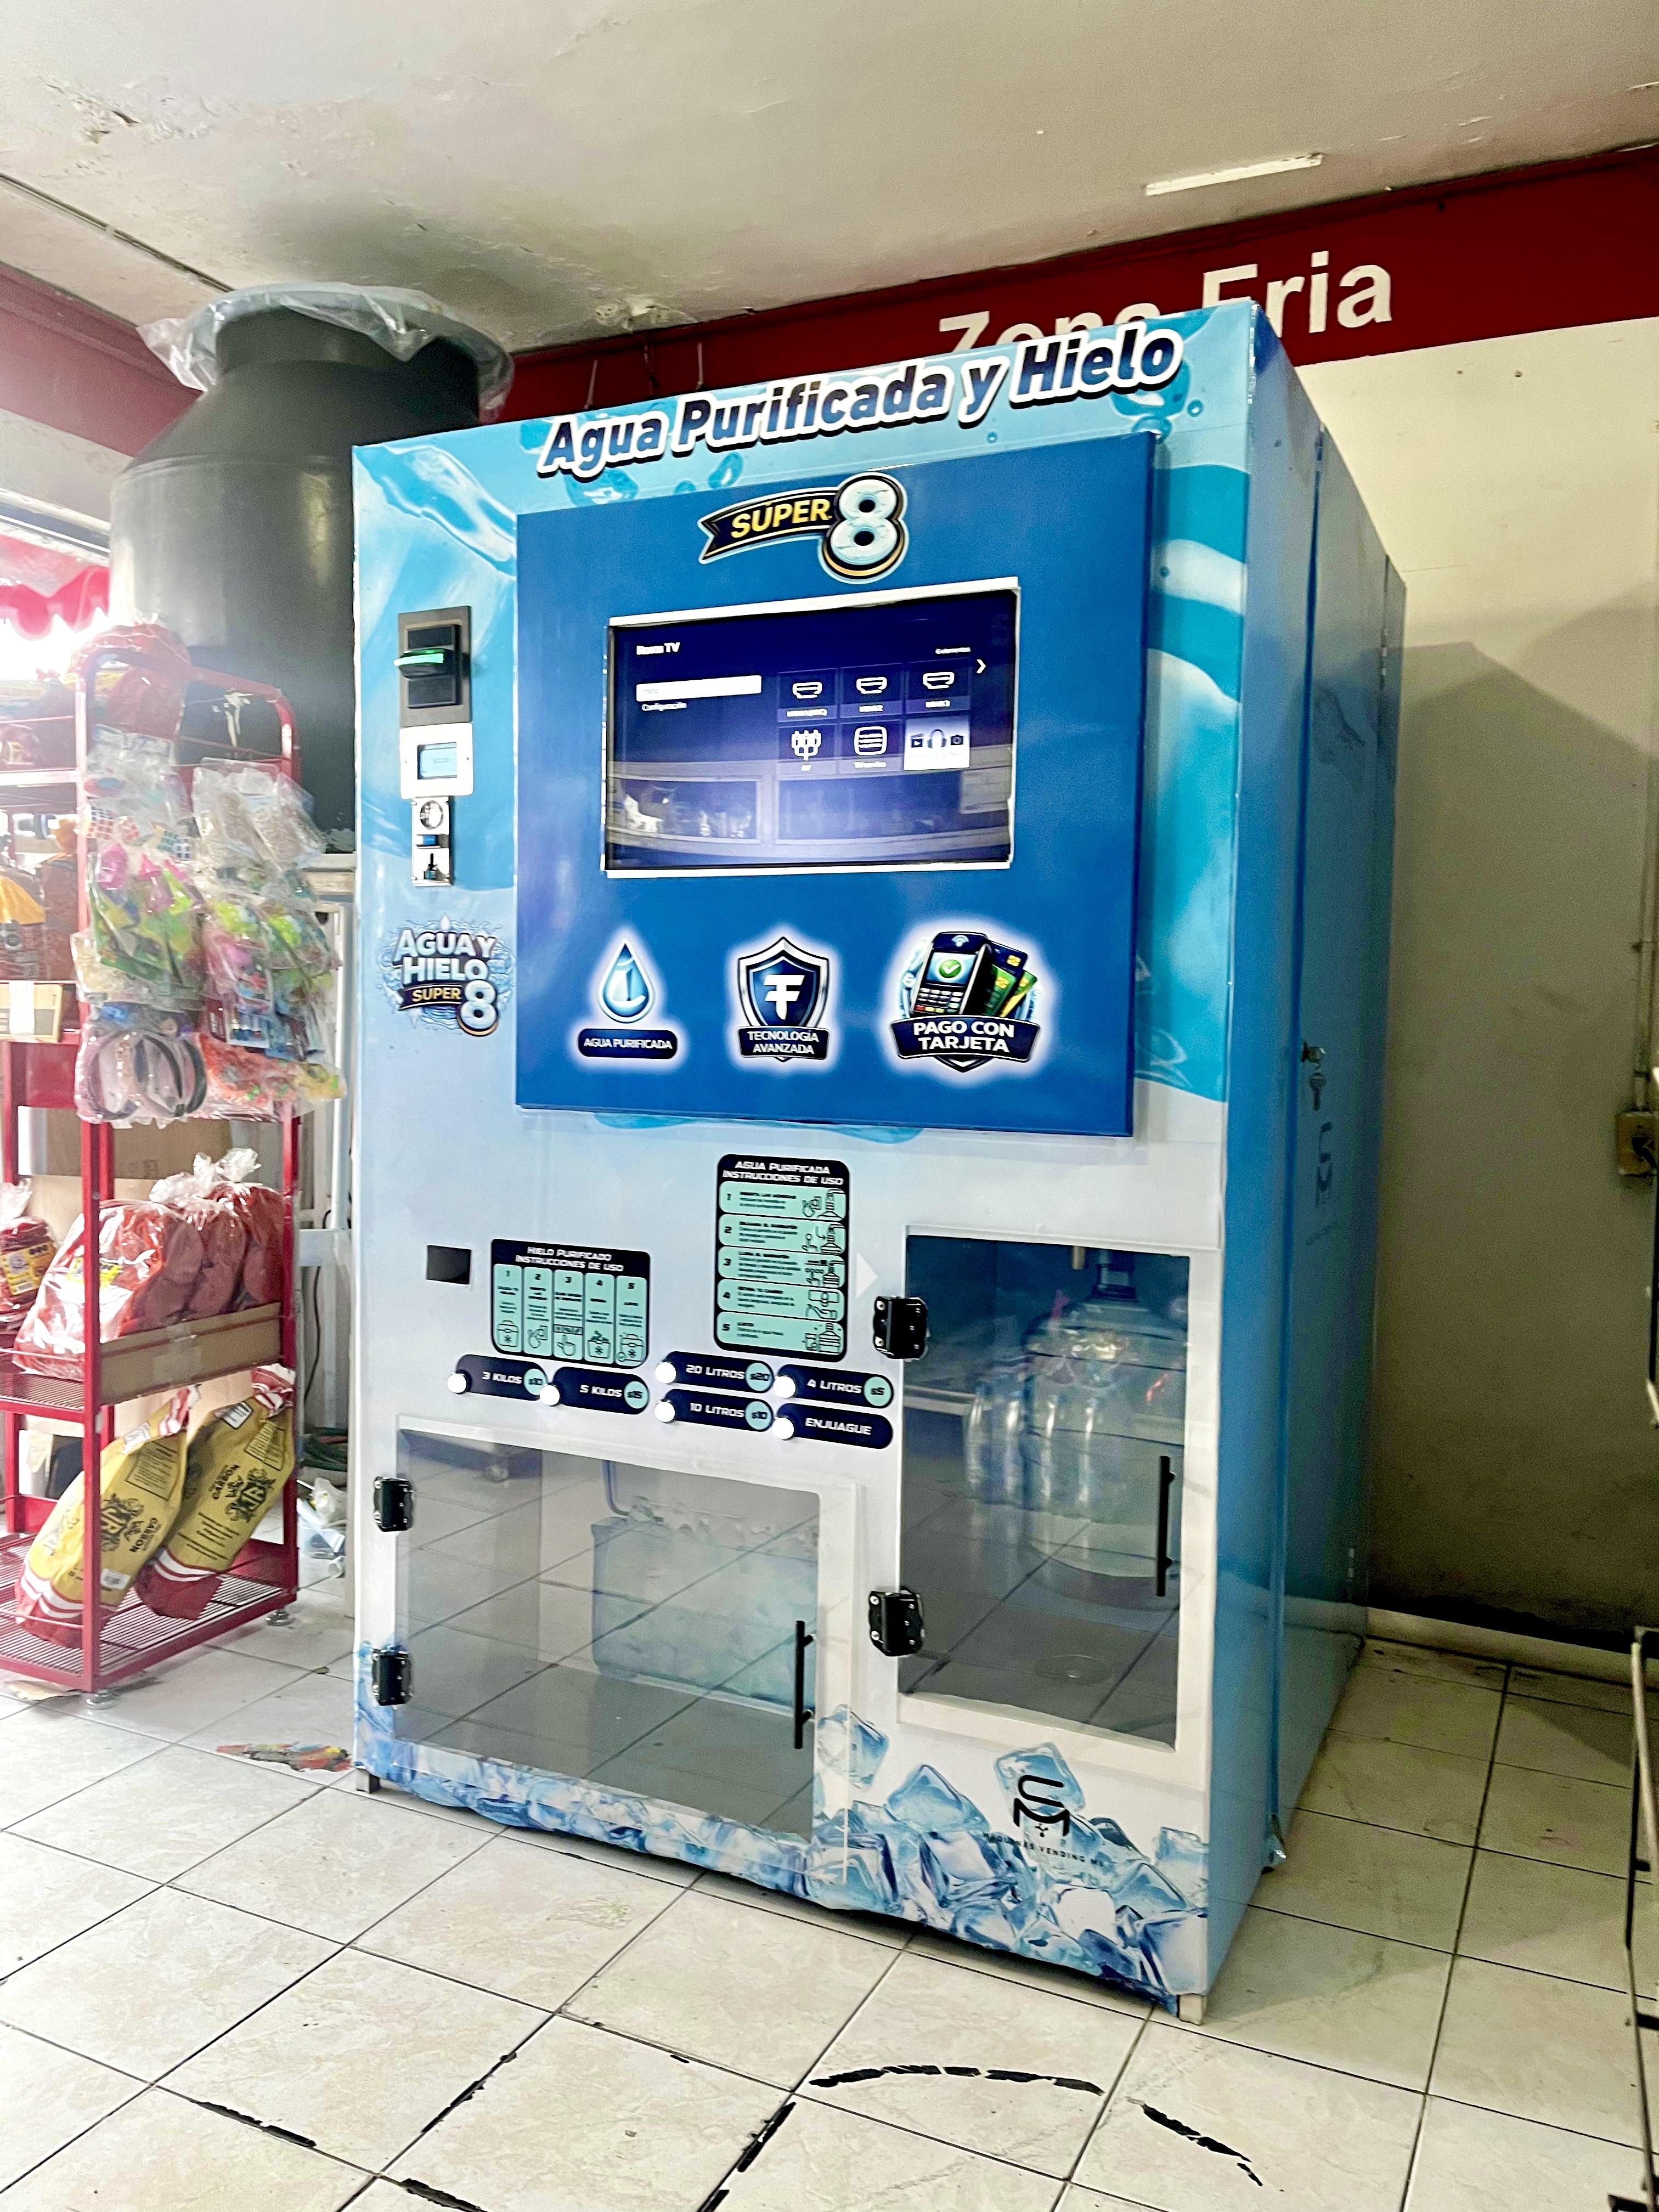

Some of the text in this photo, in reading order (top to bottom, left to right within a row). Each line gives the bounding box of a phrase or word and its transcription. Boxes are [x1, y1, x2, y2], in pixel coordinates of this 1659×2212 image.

[540, 415, 663, 475] Agua
[675, 361, 950, 450] Purificada
[962, 358, 1008, 420] y
[1012, 325, 1180, 402] Hielo
[824, 475, 905, 578] 8
[393, 929, 496, 962] AGUA Y
[402, 956, 489, 985] HIELO
[459, 979, 498, 1032] 8
[913, 1020, 1015, 1038] PAGO CON
[583, 1037, 674, 1051] AGUA PURIFICADA
[753, 1044, 815, 1056] AVANZADA
[917, 1036, 1011, 1053] TARJETA
[734, 1160, 831, 1175] AGUA PURIFICADA
[803, 1175, 819, 1184] DE
[821, 1176, 844, 1186] USO
[726, 1193, 731, 1201] 1
[724, 1226, 732, 1234] 2
[527, 1246, 612, 1262] HIELO PURIFICADO
[588, 1262, 601, 1271] DE
[602, 1263, 624, 1272] USO
[724, 1258, 731, 1267] 3
[723, 1291, 731, 1300] 4
[722, 1323, 730, 1331] 5
[482, 1372, 490, 1381] 3
[492, 1373, 523, 1385] KILOS
[685, 1364, 704, 1374] 20
[706, 1366, 746, 1380] LITROS
[579, 1384, 589, 1393] 5
[591, 1386, 623, 1398] KILOS
[807, 1379, 816, 1388] 4
[820, 1380, 862, 1395] LITROS
[690, 1402, 703, 1413] 10
[705, 1404, 745, 1419] LITROS
[805, 1418, 872, 1436] ENJUAGUE
